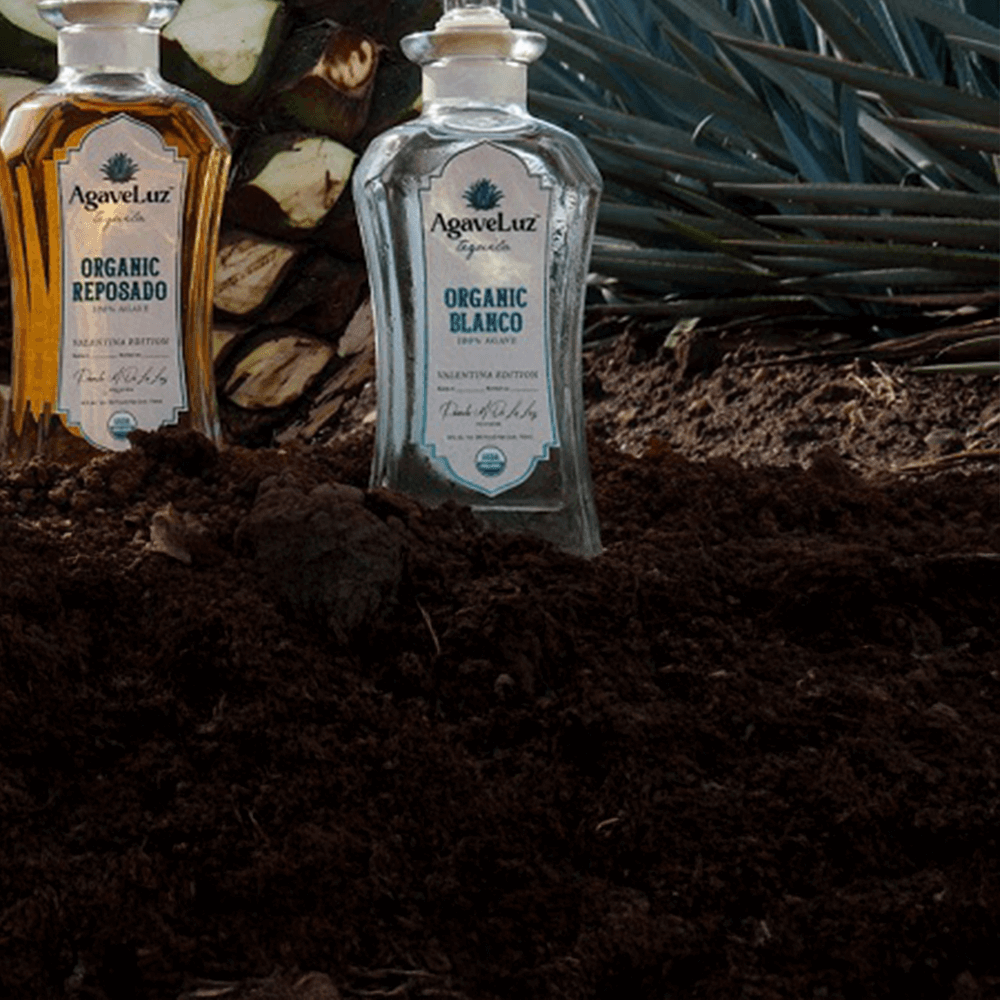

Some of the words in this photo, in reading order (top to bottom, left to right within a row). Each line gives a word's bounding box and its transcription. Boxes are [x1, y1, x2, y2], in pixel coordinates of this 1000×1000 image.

[69, 185, 171, 212] AgaveLuz
[430, 212, 537, 240] AgaveLuz
[81, 257, 160, 278] ORGANIC
[72, 281, 167, 302] REPOSADO
[444, 287, 528, 308] ORGANIC
[449, 312, 523, 333] BLANCO
